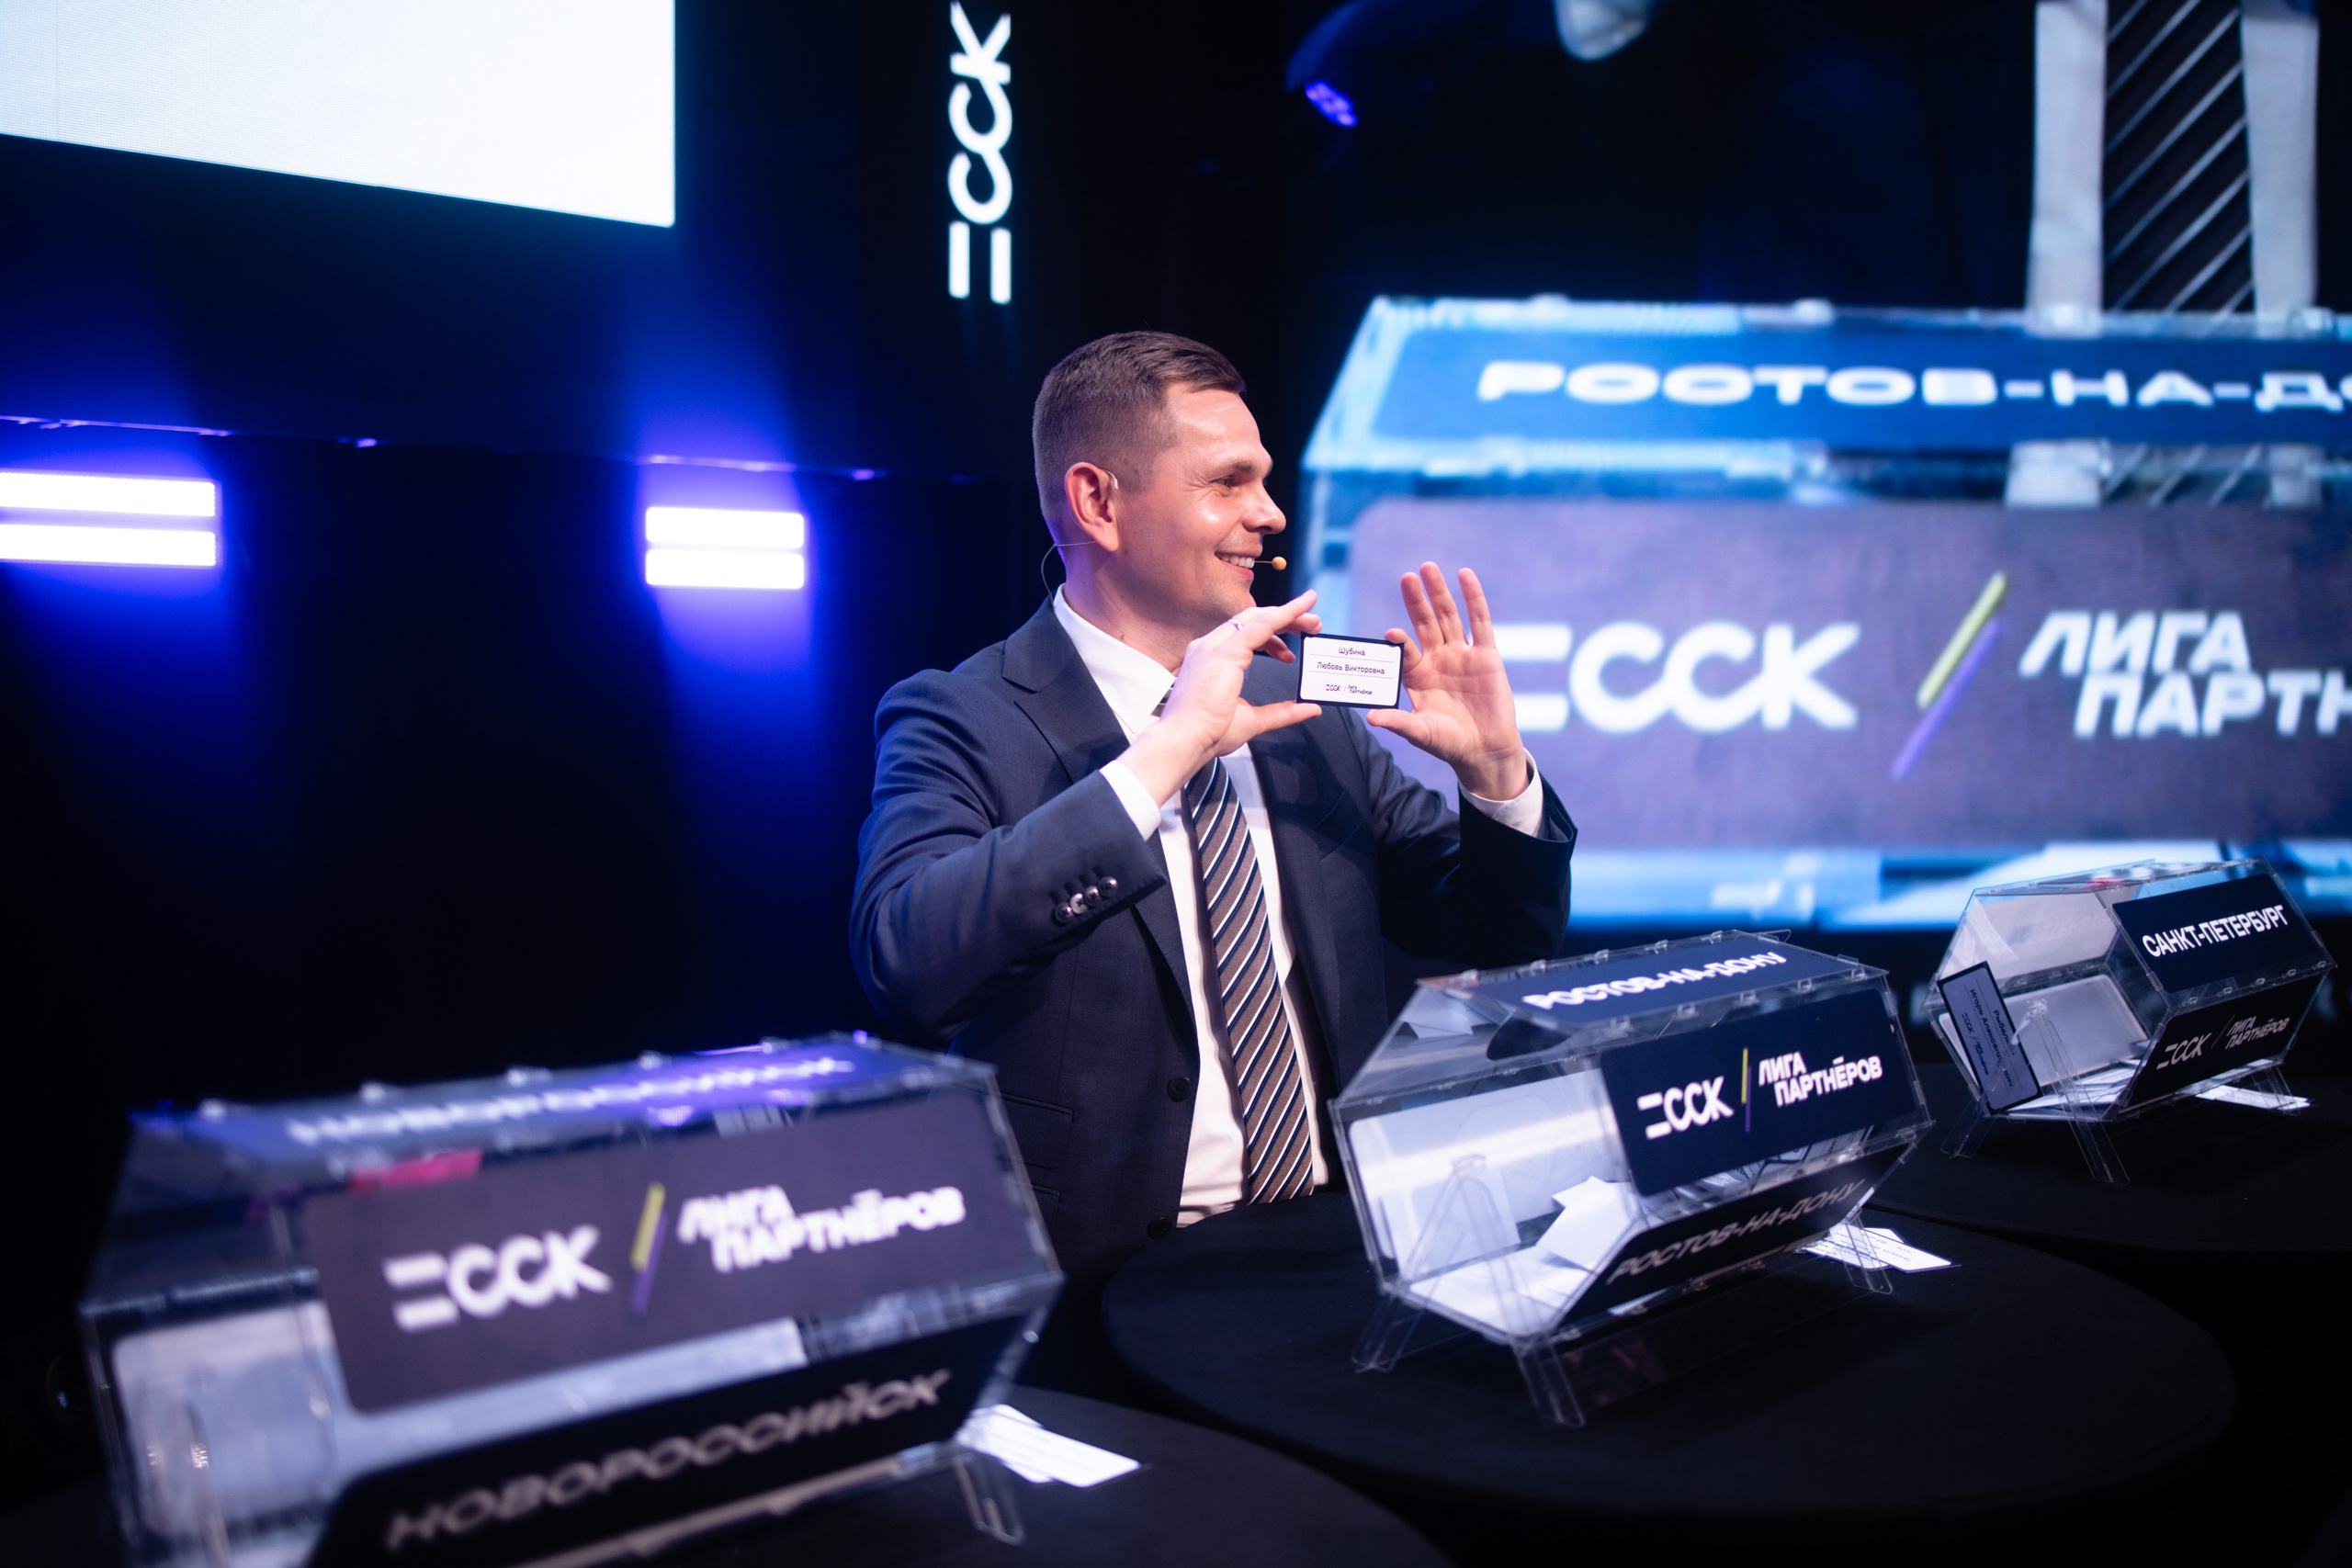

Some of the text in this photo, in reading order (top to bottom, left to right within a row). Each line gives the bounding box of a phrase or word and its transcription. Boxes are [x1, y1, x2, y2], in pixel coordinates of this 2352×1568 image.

[1476, 360, 2352, 413] РОСТОВ-НА-Д
[1317, 661, 1385, 674] Любовь Викторовна
[1338, 647, 1365, 657] Шубина
[2018, 610, 2252, 677] ЛИГА
[2142, 904, 2289, 957] САНКТ-ПЕТЕРБУРГ
[1521, 952, 1787, 1010] РОСТОВ-НА-ДОНУ
[1970, 987, 1984, 1016] Игорь
[1993, 1010, 2015, 1055] Рыбалк
[2224, 1017, 2290, 1050] ПАРТНЁРОВ
[2225, 1015, 2257, 1037] ЛИГА
[1758, 1051, 1807, 1087] ЛИГА
[1773, 1055, 1883, 1108] ПАРТНЁРОВ
[676, 1185, 796, 1245] ЛИГА
[710, 1186, 967, 1273] ПАРТНЁРОВ
[1606, 1179, 1866, 1285] РОСТОВ-НА-ДОНУ
[383, 1369, 950, 1551] НОВОРОССИЙСК
